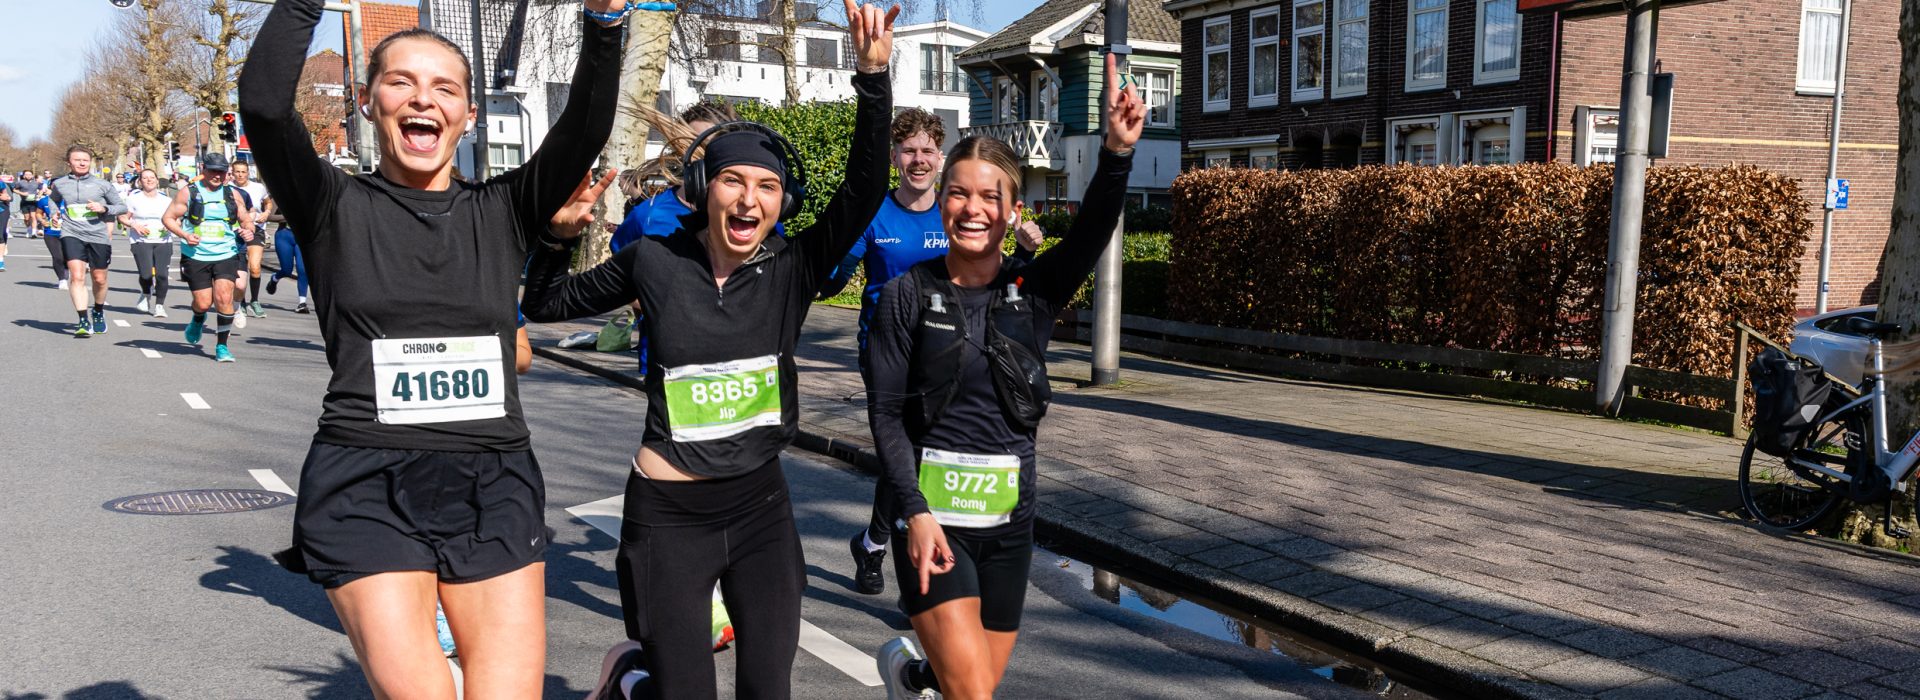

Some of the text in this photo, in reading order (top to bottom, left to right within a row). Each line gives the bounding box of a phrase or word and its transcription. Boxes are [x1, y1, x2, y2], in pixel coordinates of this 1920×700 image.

[923, 238, 950, 248] KPM
[391, 368, 490, 402] 41680
[691, 377, 758, 405] 8365
[944, 470, 998, 494] 9772
[951, 496, 987, 512] Romy
